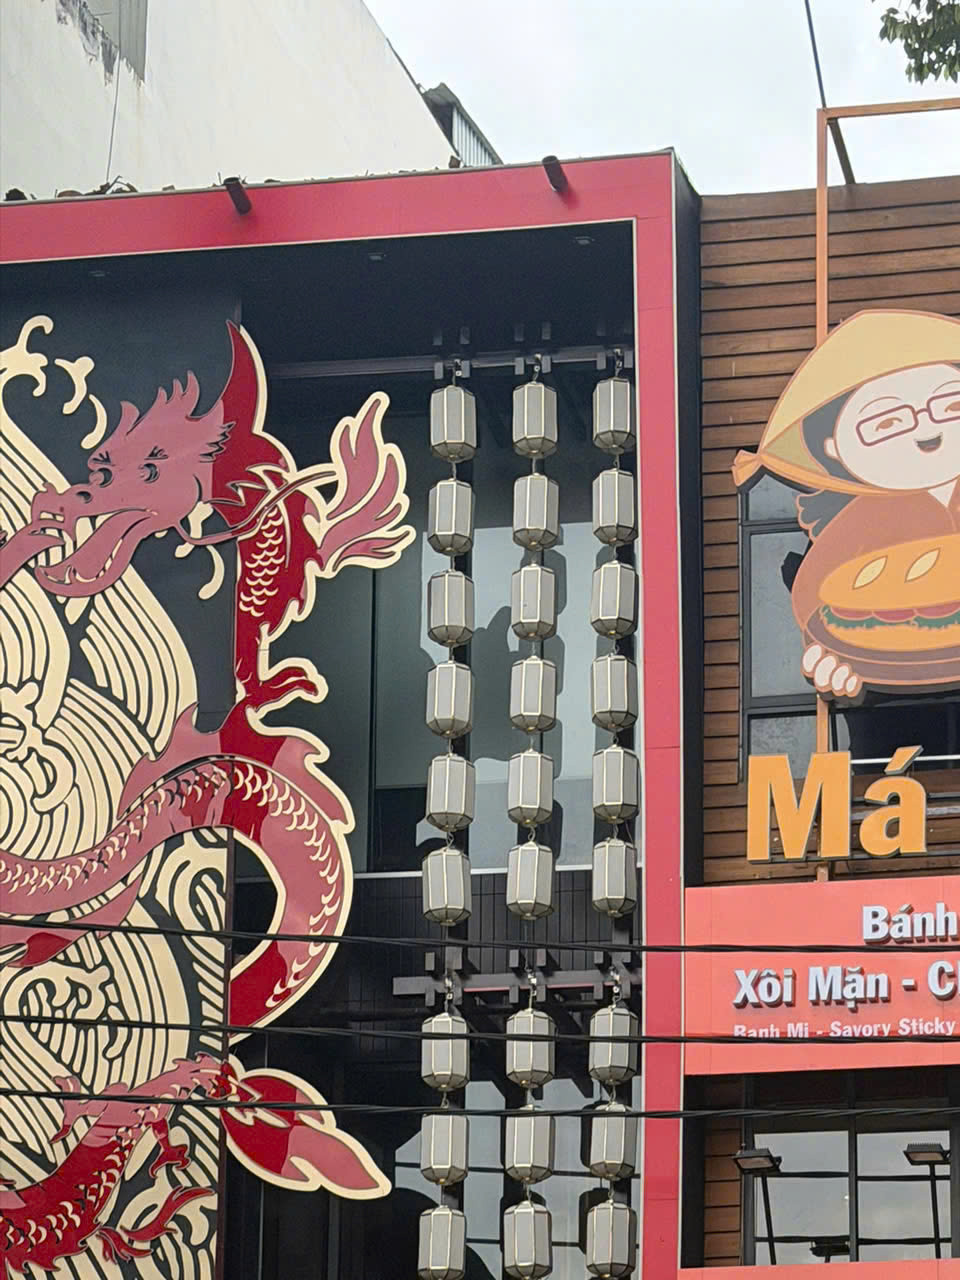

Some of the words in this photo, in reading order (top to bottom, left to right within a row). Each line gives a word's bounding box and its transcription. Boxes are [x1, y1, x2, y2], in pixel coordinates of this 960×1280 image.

[746, 745, 928, 862] Má
[862, 903, 957, 942] Bánh
[733, 968, 796, 1008] Xôi
[808, 965, 891, 1013] Mặn
[787, 1022, 809, 1038] Mi
[829, 1020, 891, 1038] Savory
[898, 1017, 956, 1036] Sticky
